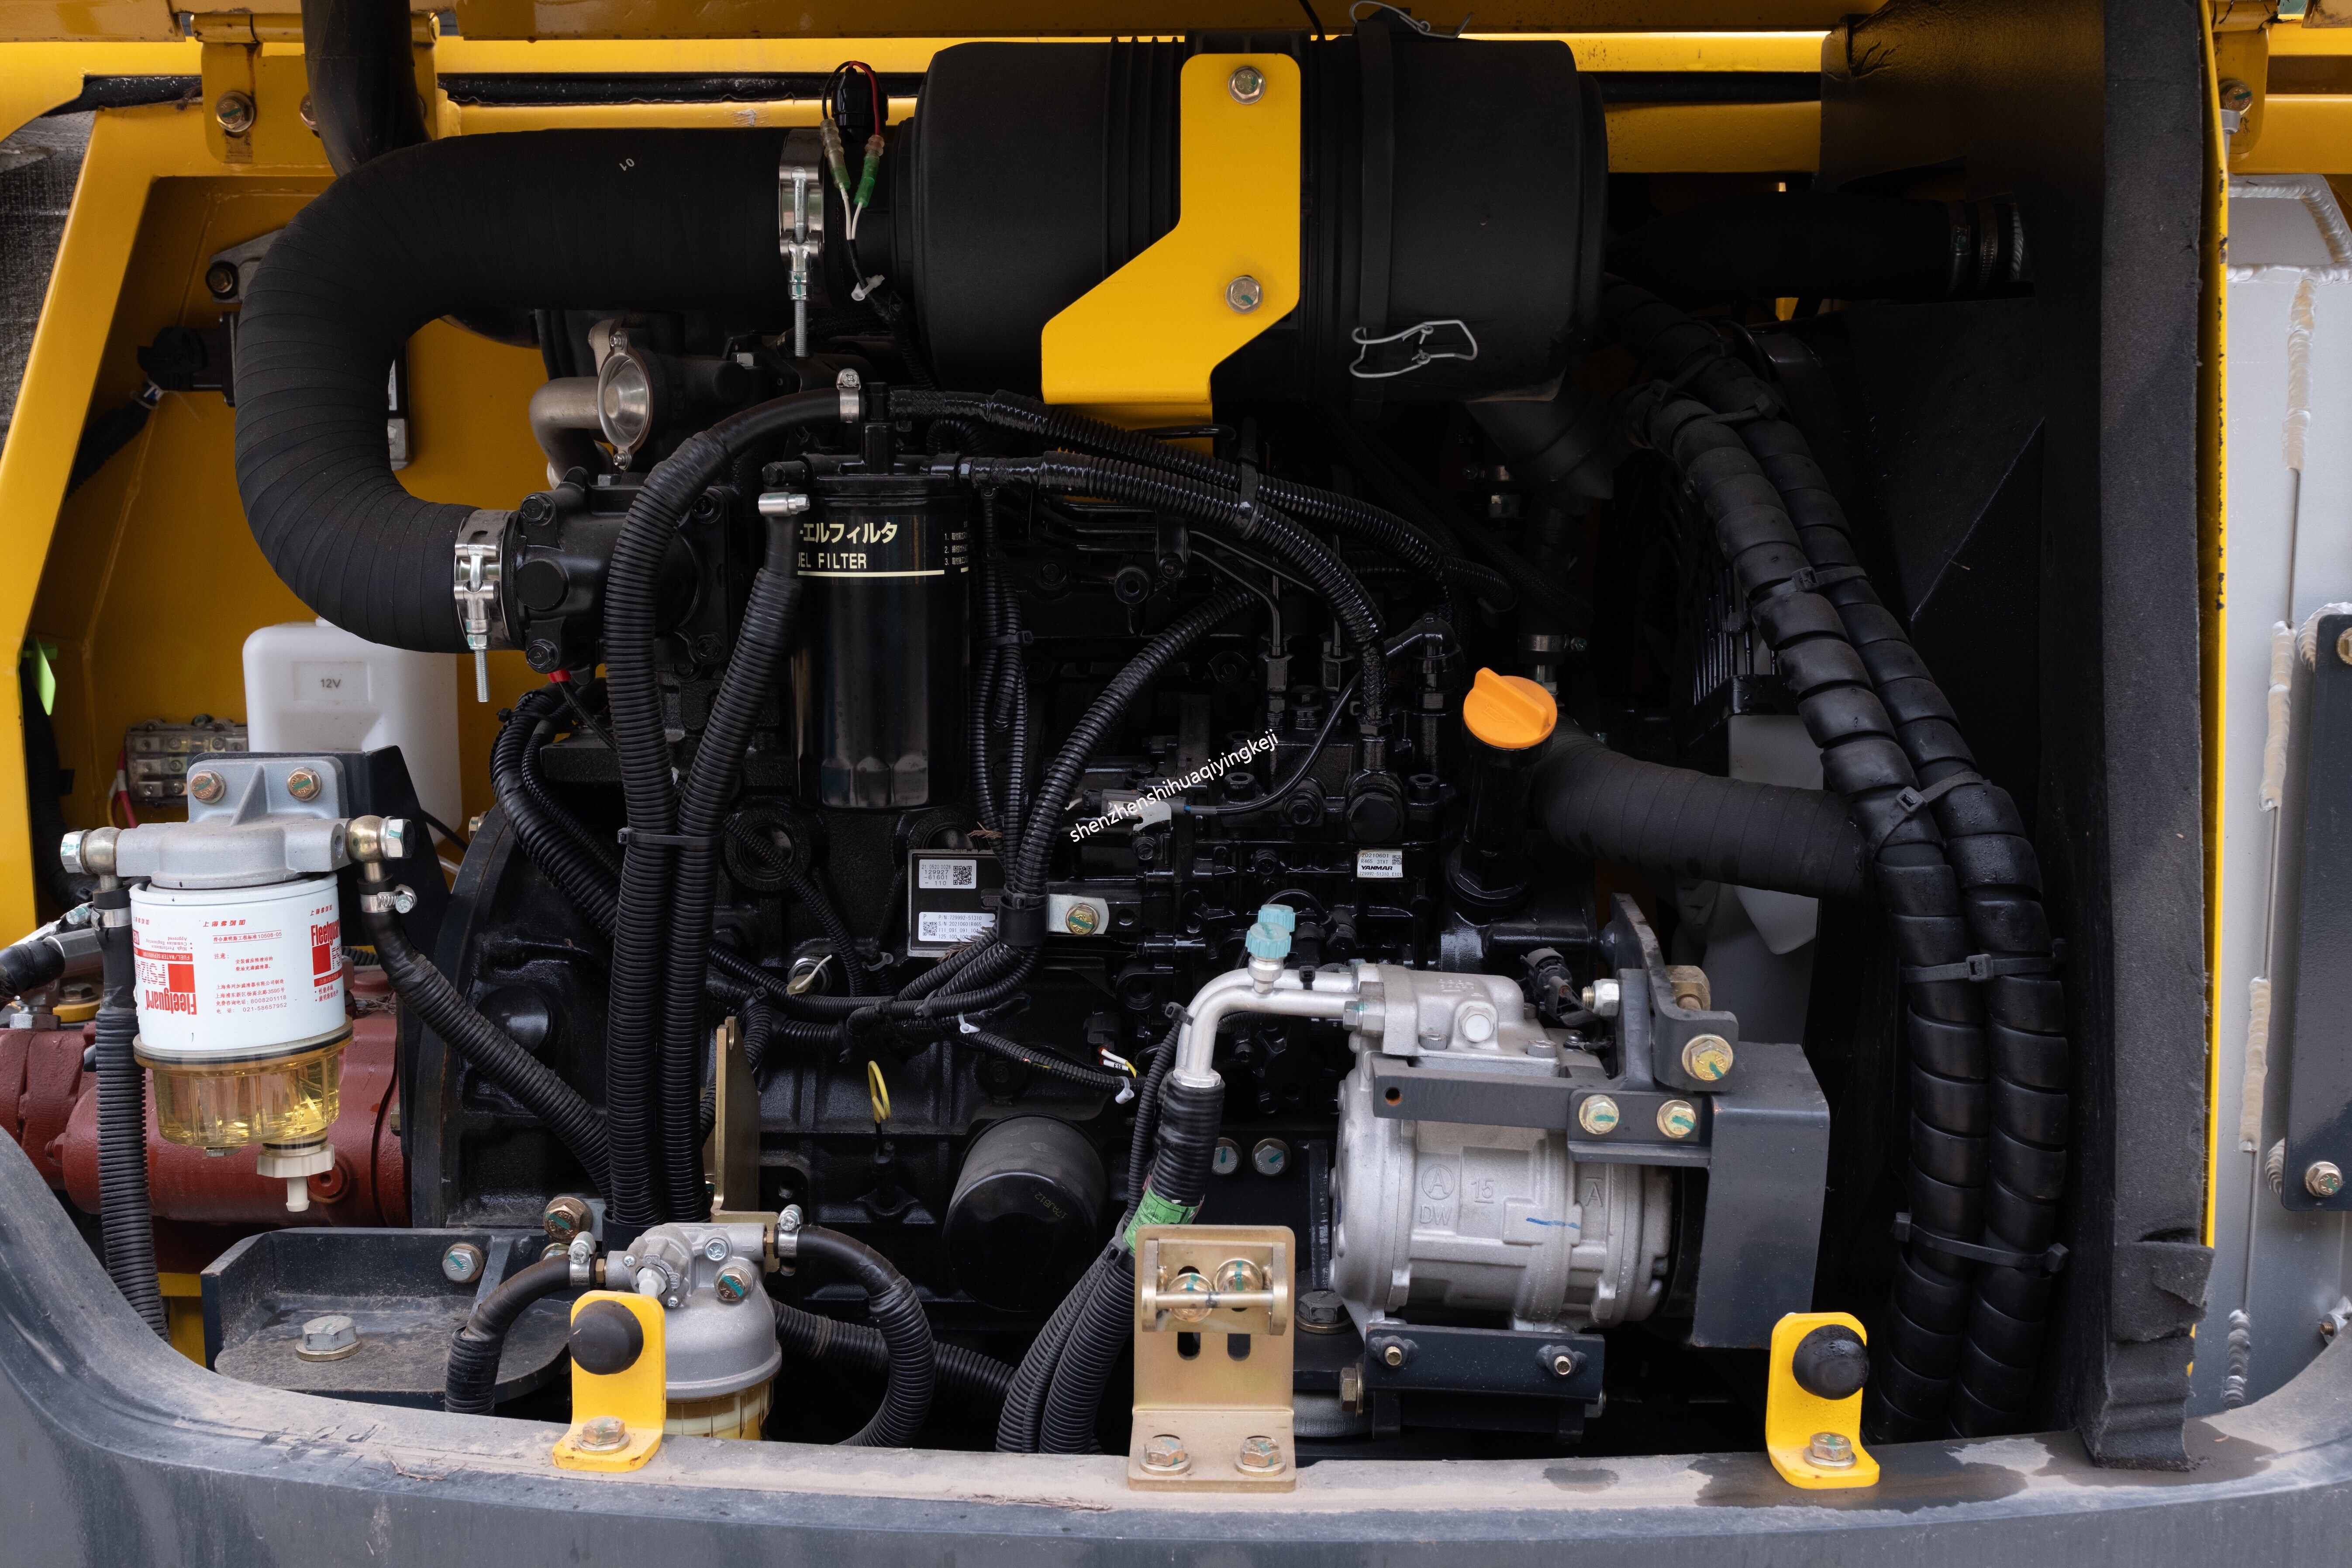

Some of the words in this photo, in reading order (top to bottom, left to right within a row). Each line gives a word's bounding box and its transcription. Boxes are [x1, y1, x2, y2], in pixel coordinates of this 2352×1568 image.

[818, 553, 867, 569] FILTER
[321, 679, 341, 689] 12V
[311, 918, 341, 947] Fleetguar
[145, 987, 197, 1015] Fleetguard
[243, 1003, 287, 1012] 021-58657952
[1471, 1179, 1494, 1199] 15
[1420, 1205, 1452, 1226] DW
